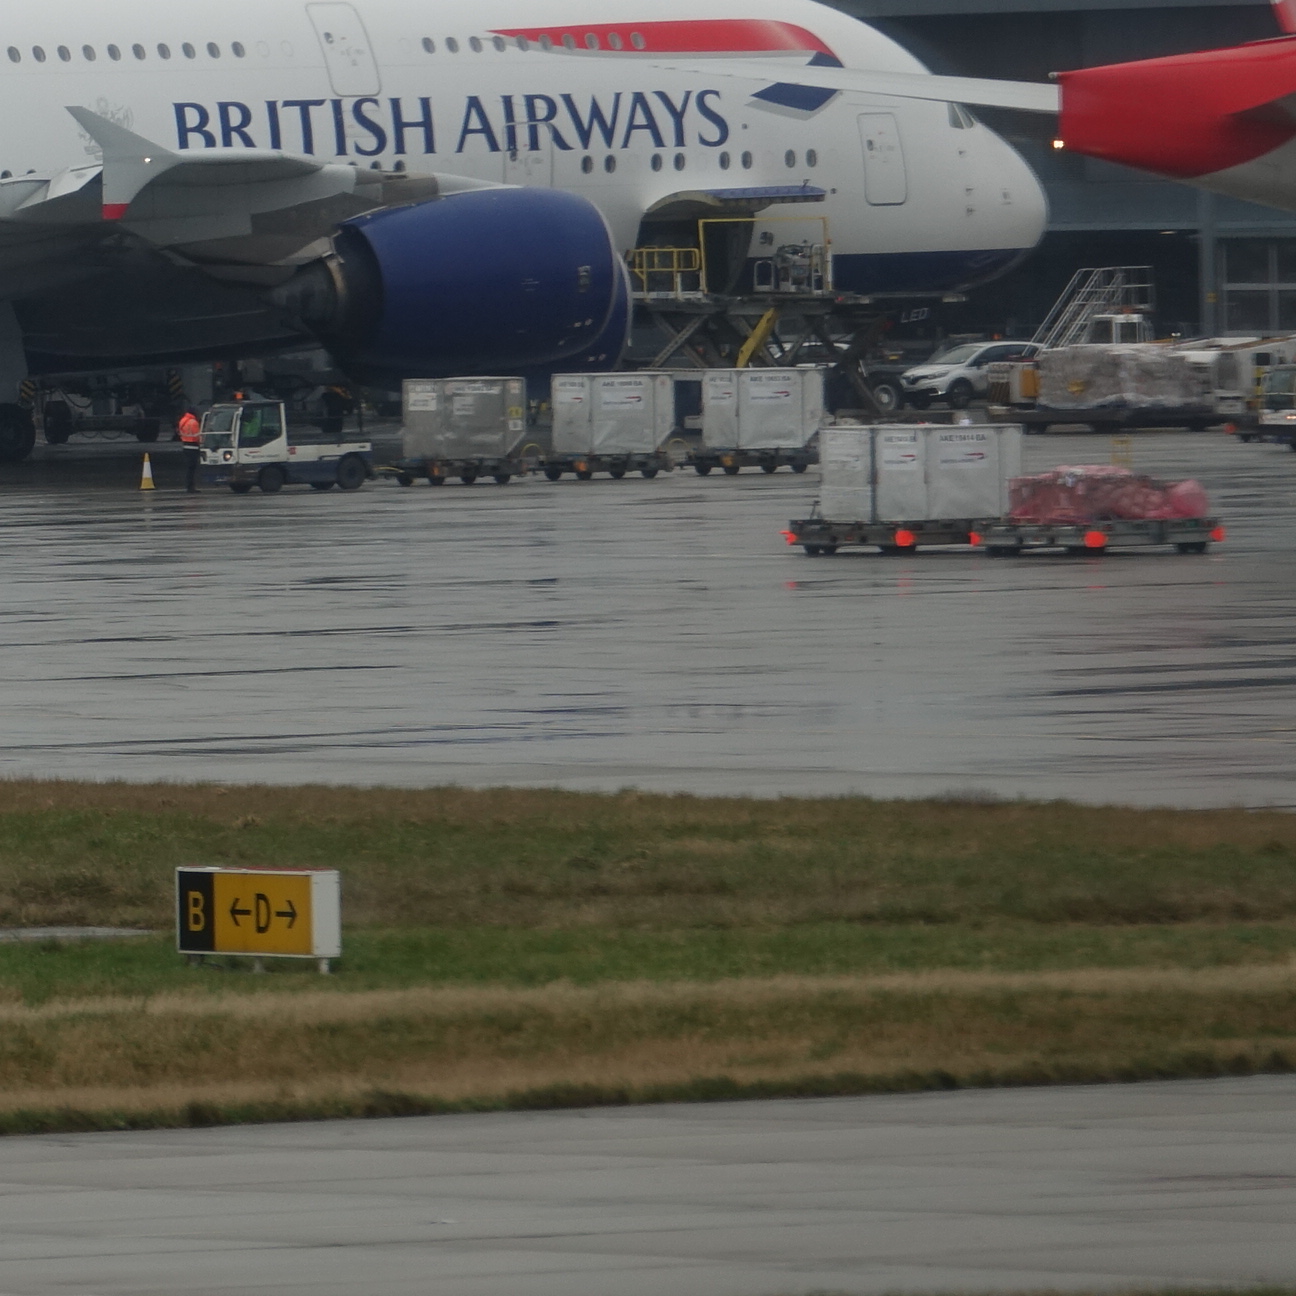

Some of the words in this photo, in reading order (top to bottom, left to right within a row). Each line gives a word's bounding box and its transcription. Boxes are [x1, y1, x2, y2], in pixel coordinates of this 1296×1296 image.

[172, 97, 437, 156] BRITISH
[455, 89, 730, 153] AIRWAYS
[900, 307, 930, 324] LED
[187, 890, 205, 932] B
[254, 892, 271, 934] D
